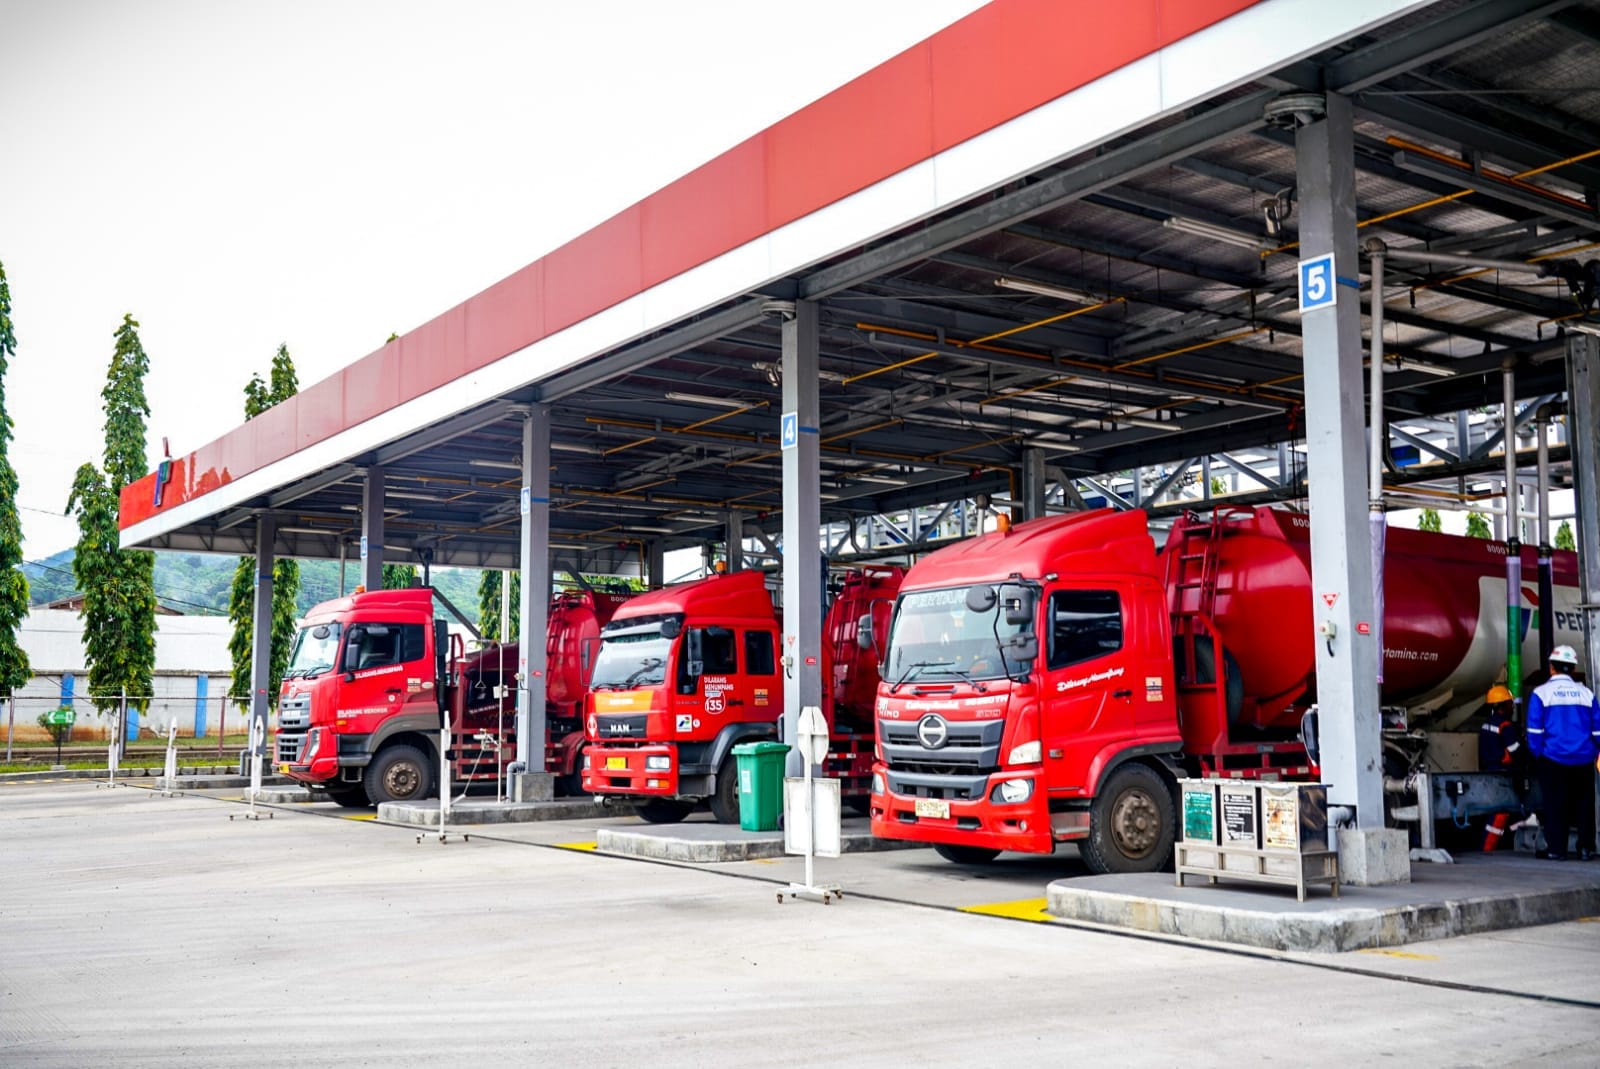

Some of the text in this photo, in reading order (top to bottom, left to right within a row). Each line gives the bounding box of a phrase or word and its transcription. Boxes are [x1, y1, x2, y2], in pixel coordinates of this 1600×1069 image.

[1307, 265, 1326, 301] 5
[784, 418, 795, 443] 4
[1292, 517, 1310, 528] 800
[706, 699, 722, 711] 135
[879, 710, 899, 718] HINO
[610, 723, 630, 733] MAN
